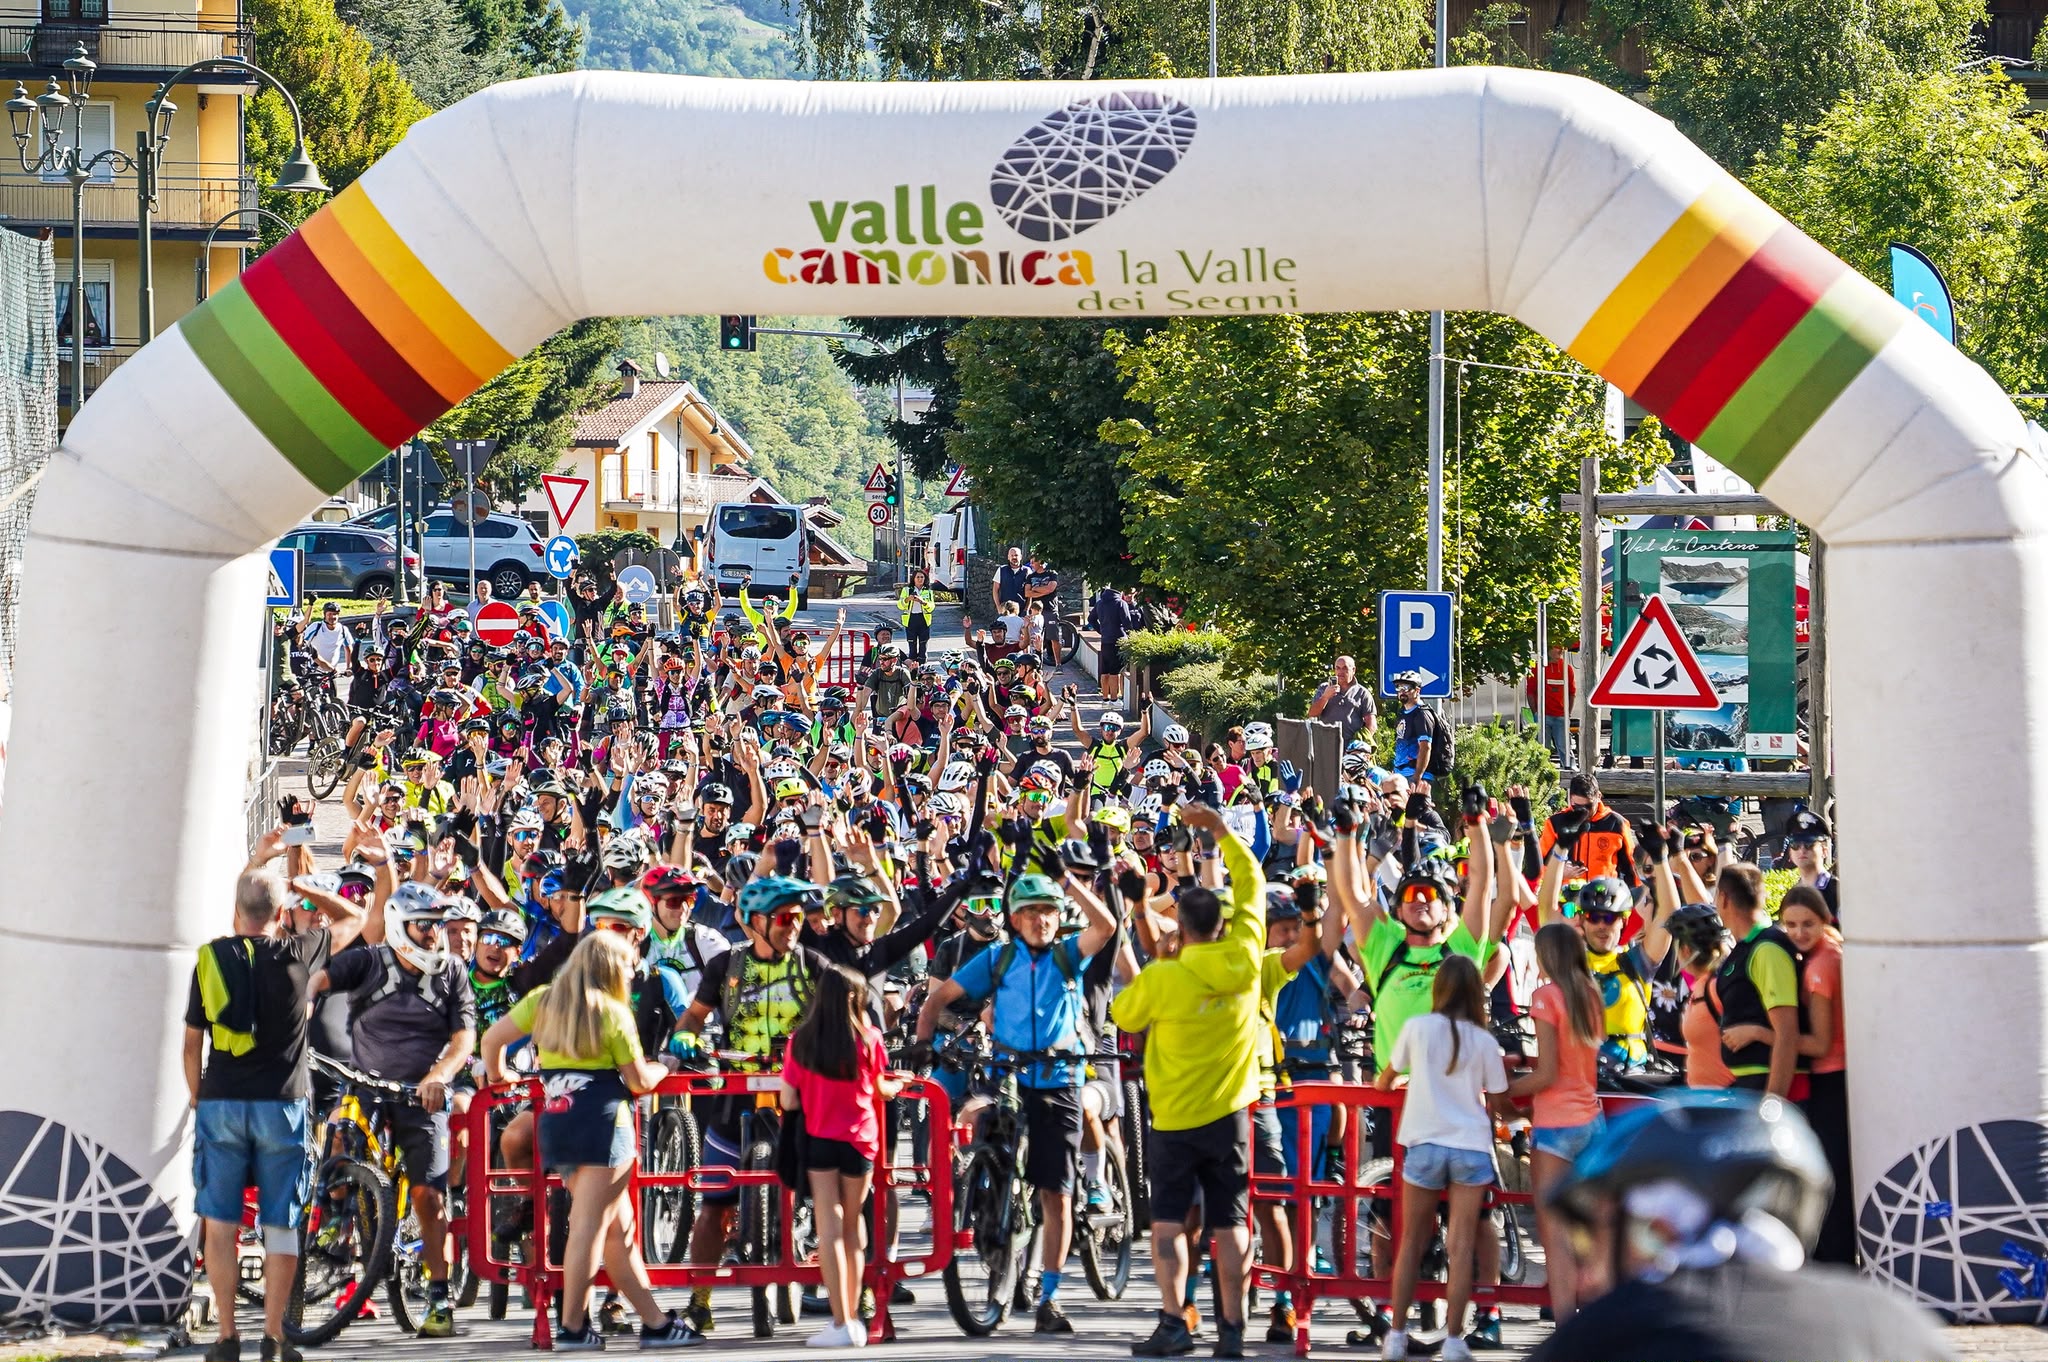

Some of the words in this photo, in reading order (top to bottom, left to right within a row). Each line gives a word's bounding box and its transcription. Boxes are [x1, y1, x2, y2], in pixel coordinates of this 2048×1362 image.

[808, 184, 984, 245] valle
[763, 246, 1096, 287] camonica
[1118, 249, 1159, 285] la
[1175, 246, 1298, 285] Valle
[1078, 290, 1145, 312] dei
[872, 508, 885, 520] 30
[1621, 535, 1656, 555] Val
[1660, 538, 1683, 551] di
[1685, 536, 1760, 554] Corteno
[1398, 601, 1436, 658] P
